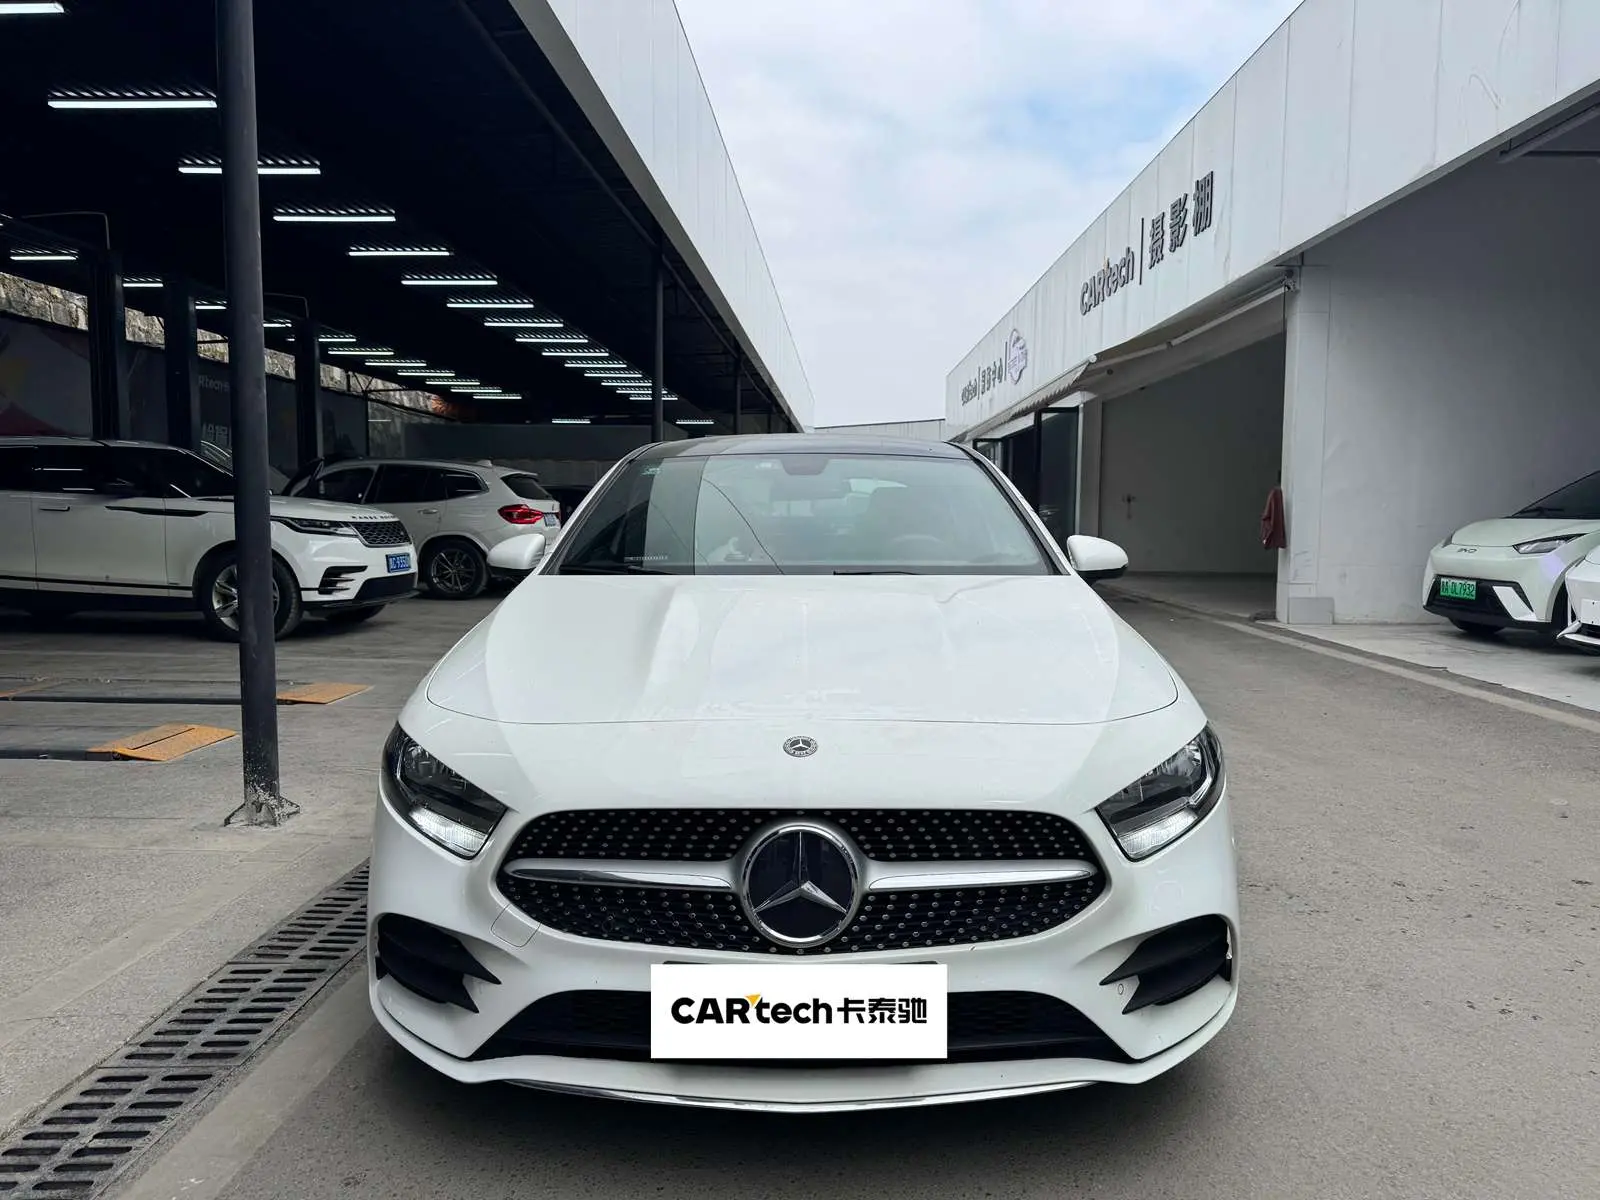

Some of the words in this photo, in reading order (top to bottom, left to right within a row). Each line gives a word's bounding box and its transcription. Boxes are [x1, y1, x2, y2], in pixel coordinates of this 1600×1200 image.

[1080, 247, 1135, 315] CARtech
[1148, 171, 1214, 270] 摄影棚
